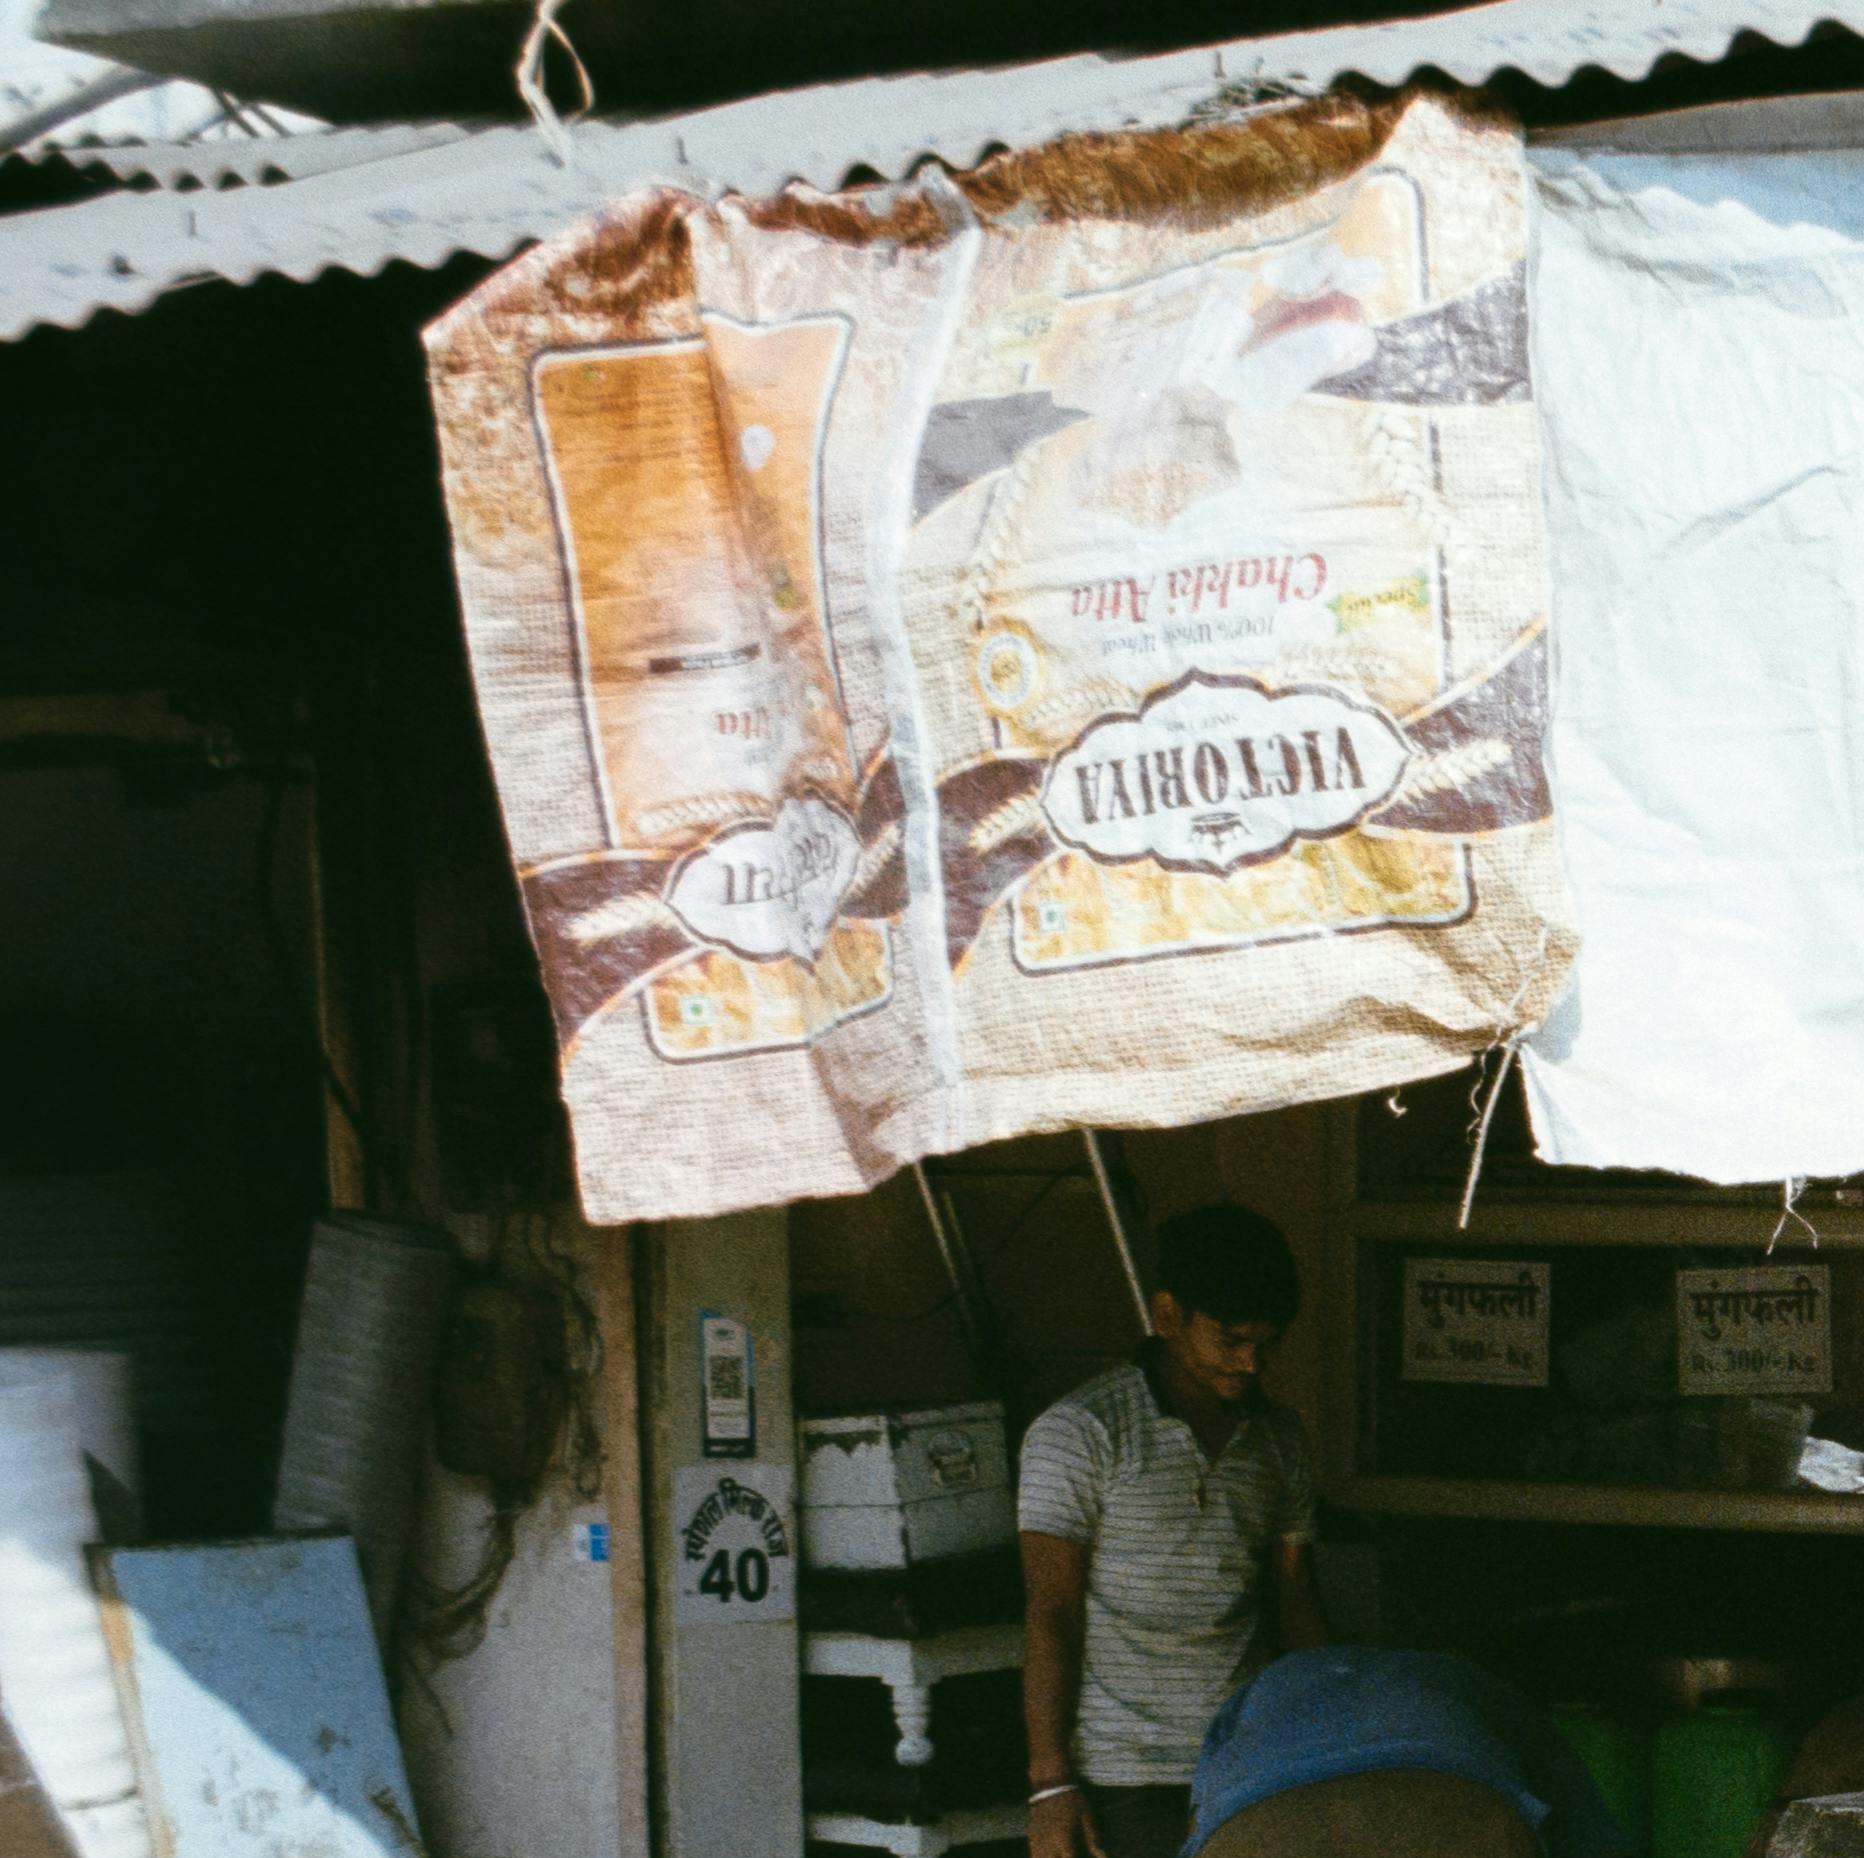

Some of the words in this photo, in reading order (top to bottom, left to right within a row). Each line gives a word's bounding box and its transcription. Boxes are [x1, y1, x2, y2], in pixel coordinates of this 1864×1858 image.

[1071, 576, 1156, 625] Atta
[1167, 551, 1328, 616] Chakki
[1100, 631, 1157, 656] Wheat
[1216, 615, 1275, 644] 100%
[1074, 726, 1366, 827] VICTORIYA
[699, 1547, 770, 1603] 40
